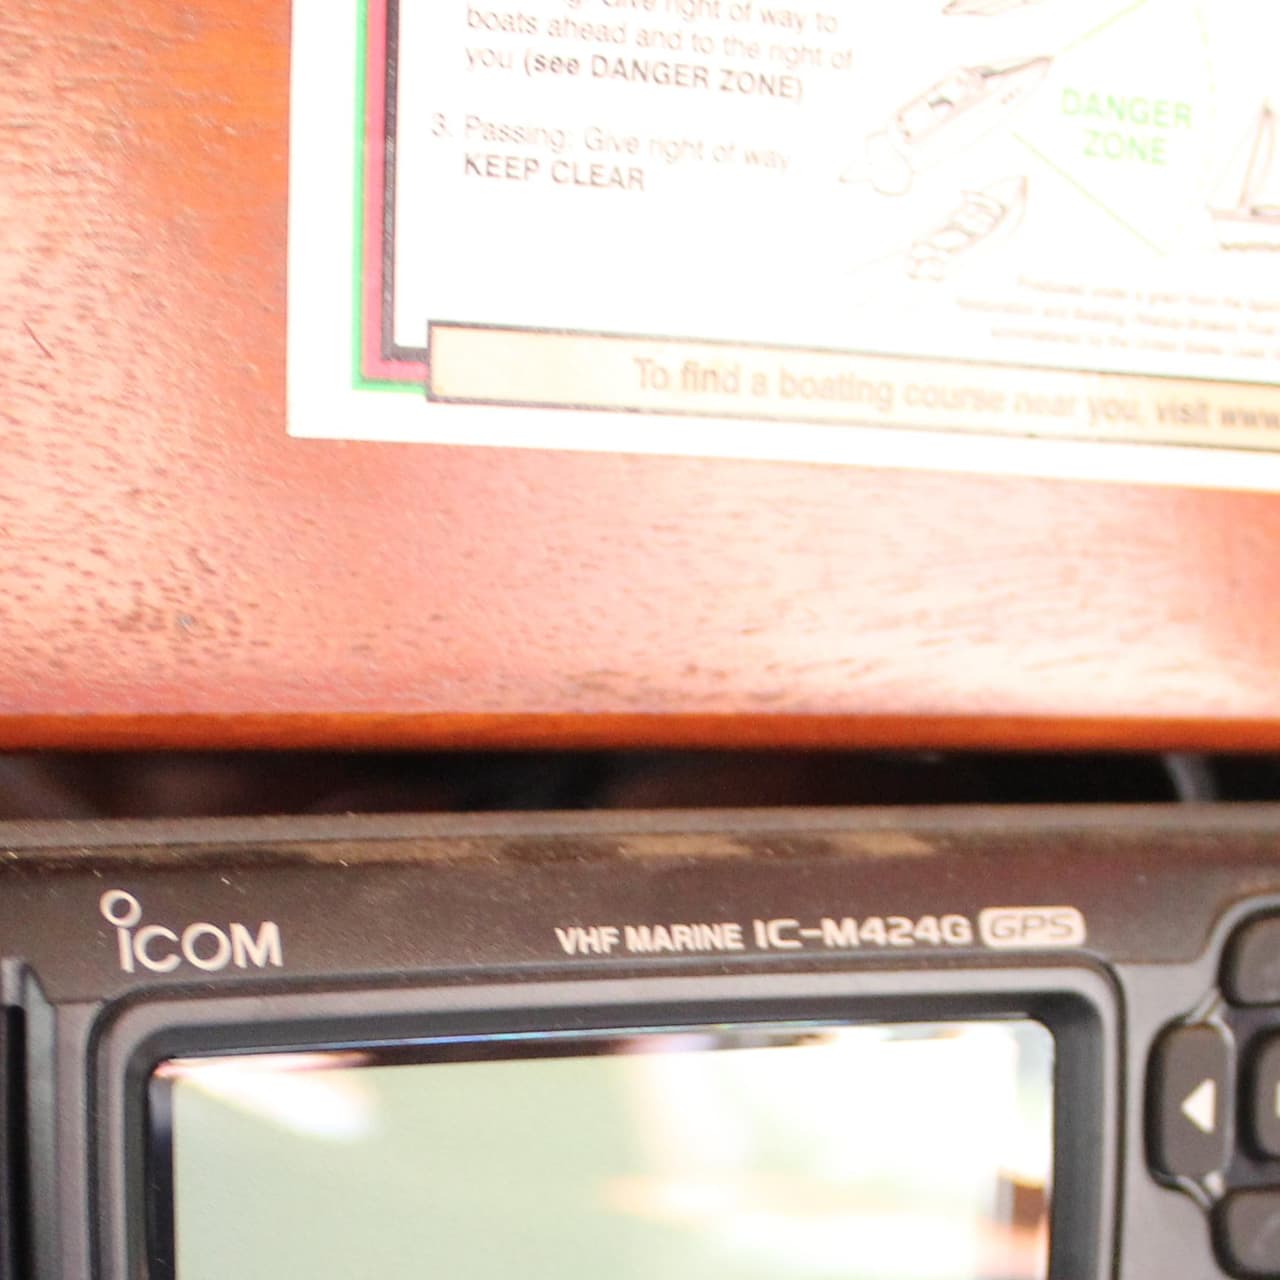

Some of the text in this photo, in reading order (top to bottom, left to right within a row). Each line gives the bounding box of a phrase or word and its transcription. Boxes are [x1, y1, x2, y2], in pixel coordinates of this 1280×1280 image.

[466, 4, 853, 71] boats ahead and to the right of
[759, 8, 806, 34] way
[816, 11, 838, 33] to
[464, 47, 803, 104] you (see DANGER ZONE)
[1061, 86, 1193, 128] DANGER
[430, 112, 791, 174] 3. Passing: Give right of way
[1082, 128, 1168, 166] ZONE
[463, 151, 645, 192] KEEP CLEAR
[634, 356, 671, 392] To
[680, 359, 741, 396] find
[751, 371, 768, 397] a
[779, 366, 896, 411] boating
[903, 381, 1006, 414] course
[1013, 390, 1076, 419] near
[555, 913, 1076, 955] VHF MARINE IC-M424G GPS
